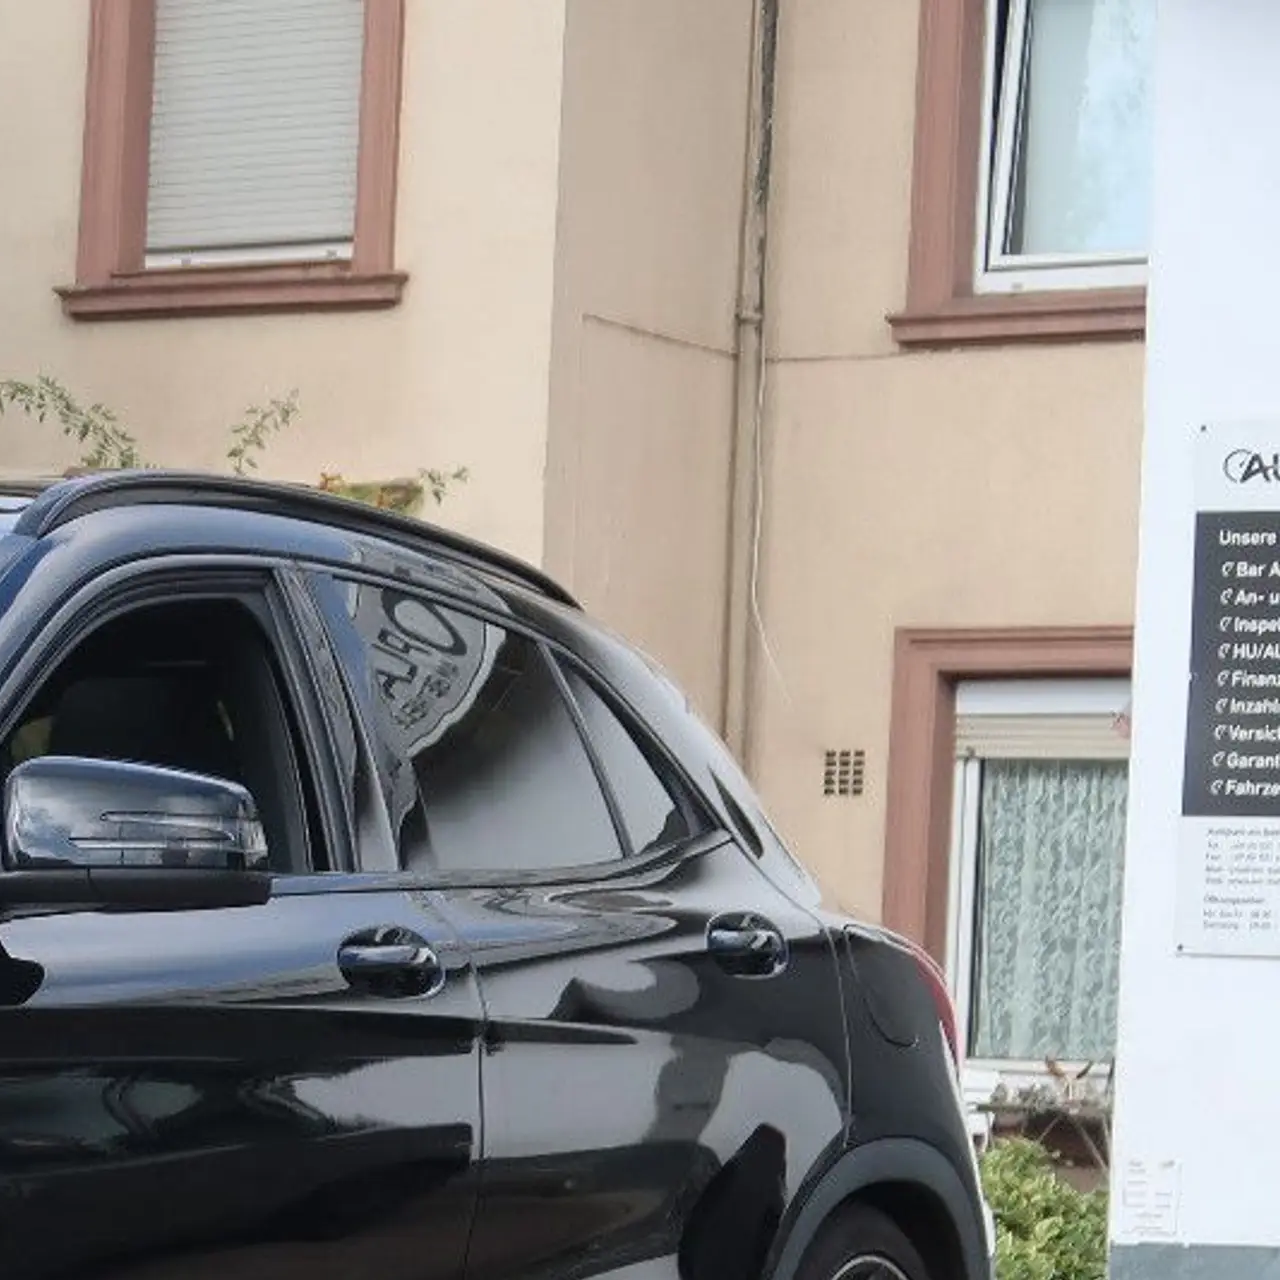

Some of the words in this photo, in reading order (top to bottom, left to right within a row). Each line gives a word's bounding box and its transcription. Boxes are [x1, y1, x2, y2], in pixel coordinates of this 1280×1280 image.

[1219, 530, 1276, 546] Unsere
[1237, 561, 1265, 577] Bar
[1234, 589, 1264, 605] An-
